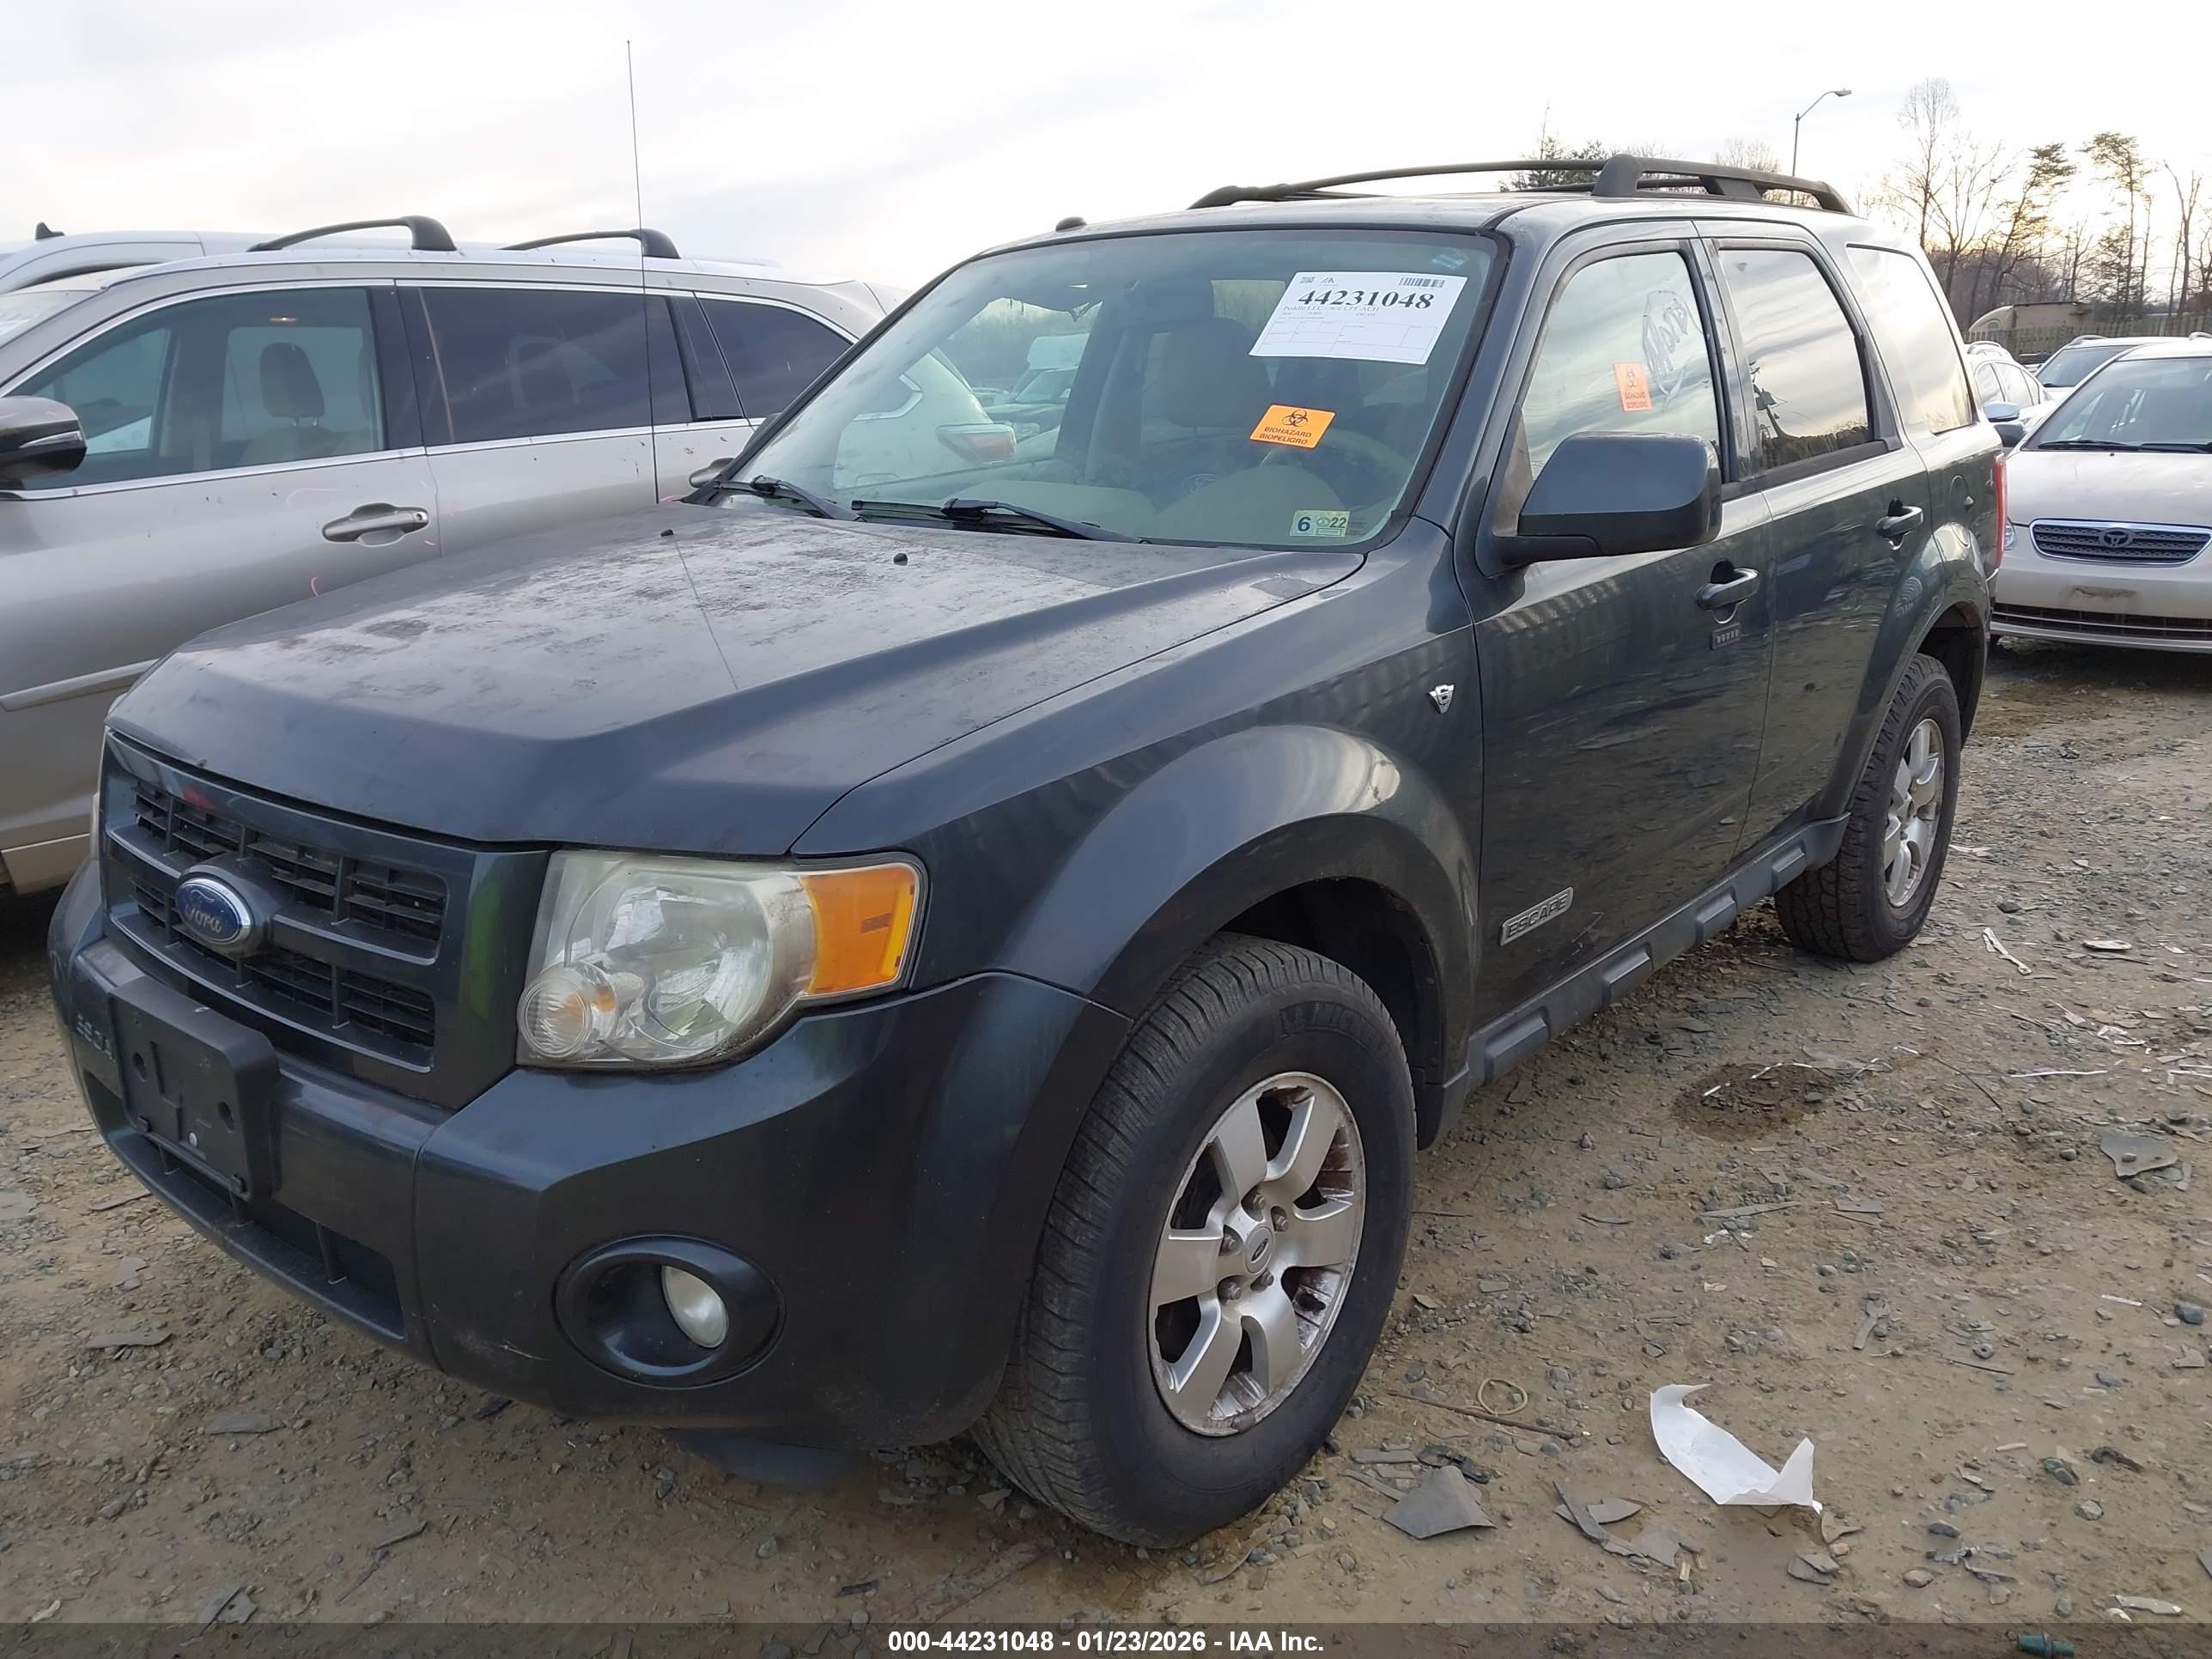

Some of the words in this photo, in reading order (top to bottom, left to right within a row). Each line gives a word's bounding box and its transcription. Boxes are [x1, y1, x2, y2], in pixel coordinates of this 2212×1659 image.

[1297, 289, 1436, 309] 44231048
[1259, 433, 1308, 445] BIOPELIGRO
[1264, 426, 1312, 438] BIOHAZARD
[1297, 516, 1311, 532] 6
[1329, 517, 1346, 528] 22
[1507, 893, 1569, 938] ESCAPE
